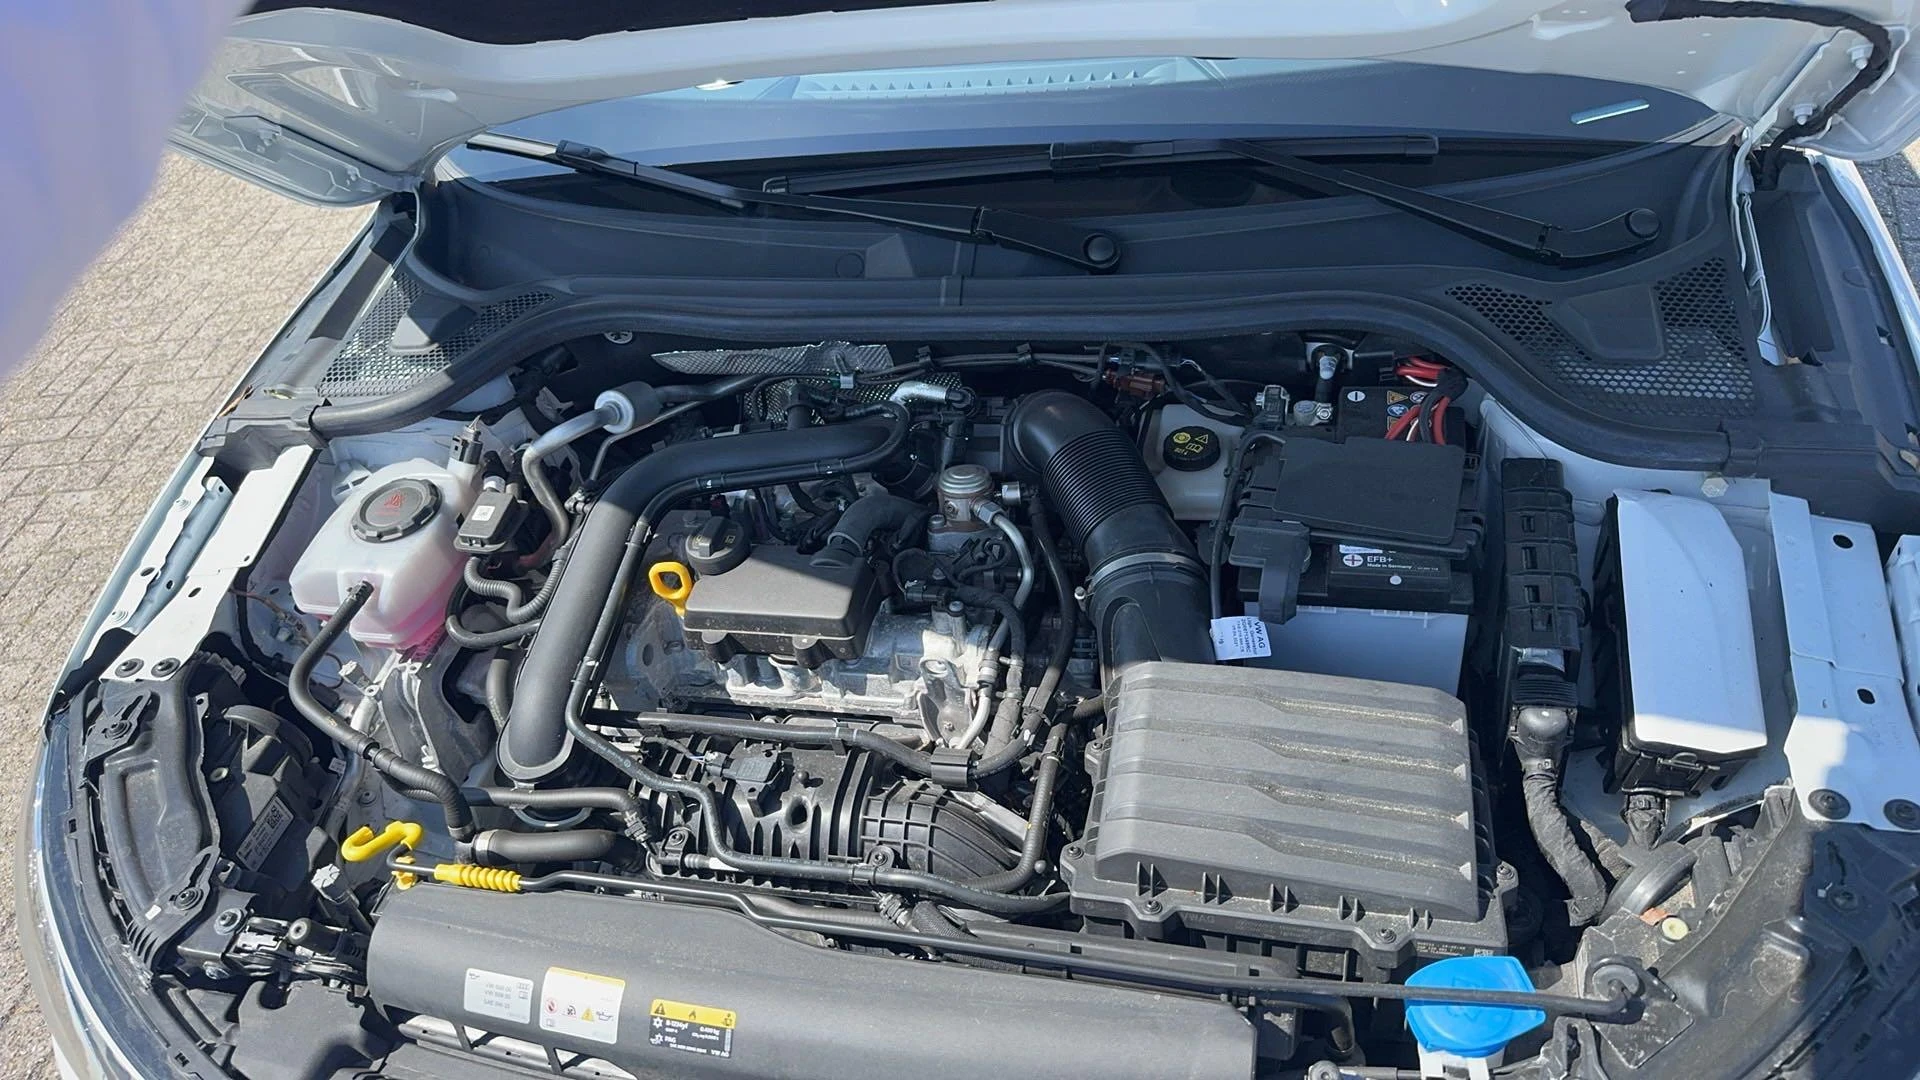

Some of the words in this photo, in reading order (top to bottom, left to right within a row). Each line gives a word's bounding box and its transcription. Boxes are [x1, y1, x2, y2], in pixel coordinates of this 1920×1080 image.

[1367, 555, 1393, 563] EFB+
[1254, 621, 1262, 635] VW
[1257, 636, 1266, 649] AG
